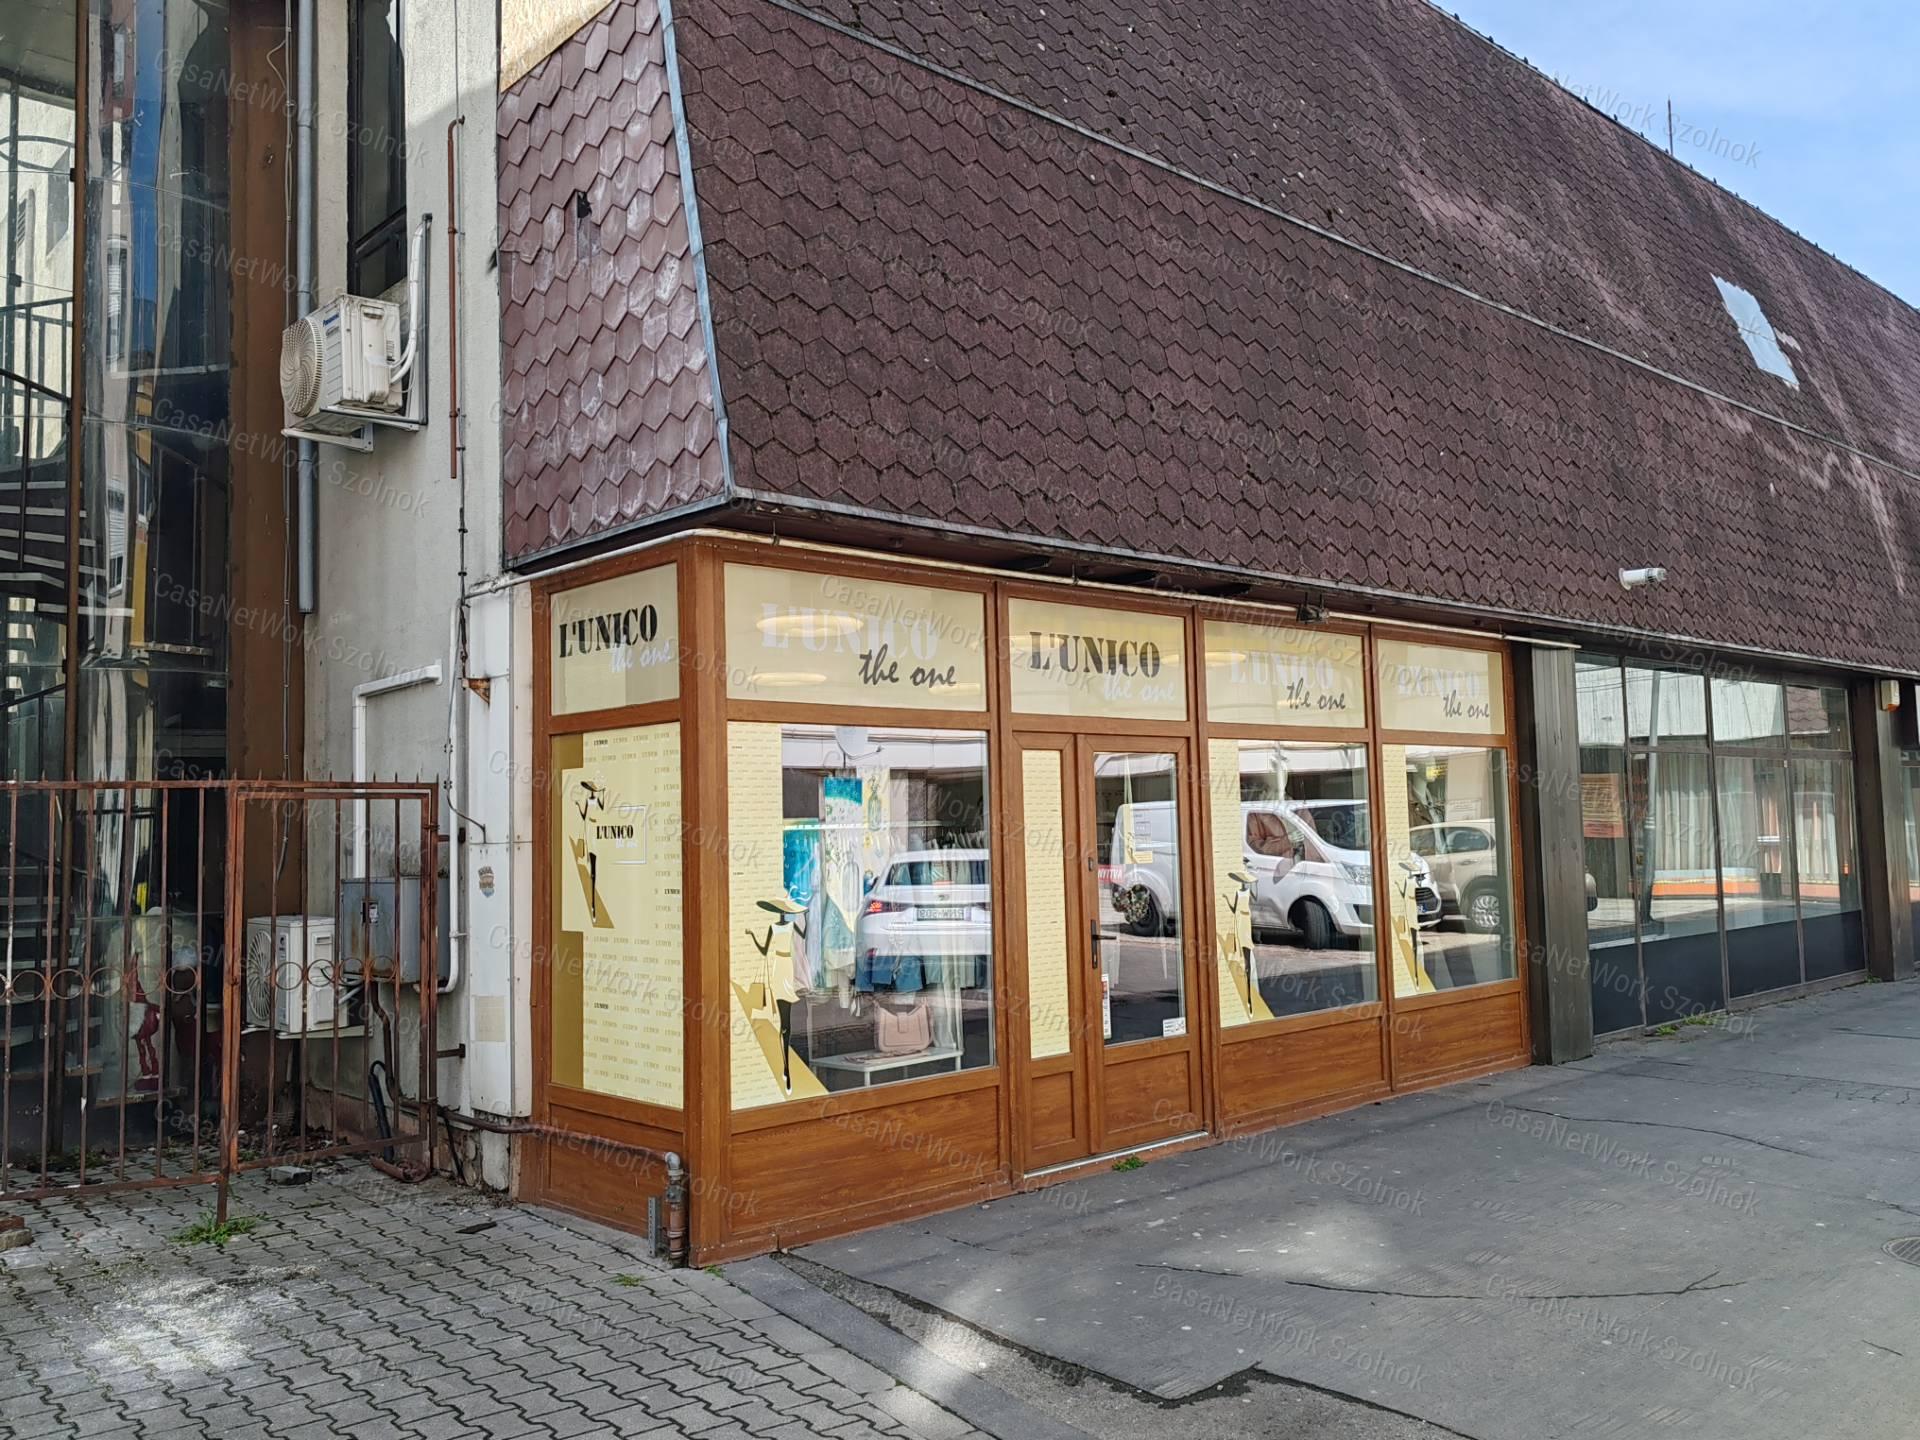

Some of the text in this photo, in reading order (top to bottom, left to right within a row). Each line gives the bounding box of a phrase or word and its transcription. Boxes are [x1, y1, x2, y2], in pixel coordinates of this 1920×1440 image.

[559, 604, 657, 658] L'UNICO
[761, 603, 939, 660] L'UNICO
[609, 635, 672, 672] the one
[859, 643, 956, 688] the one
[1029, 631, 1160, 678] L'UNICO
[1103, 664, 1132, 698] the
[1286, 677, 1346, 710] the one
[1443, 689, 1489, 719] the one
[597, 825, 633, 839] L'UNICO
